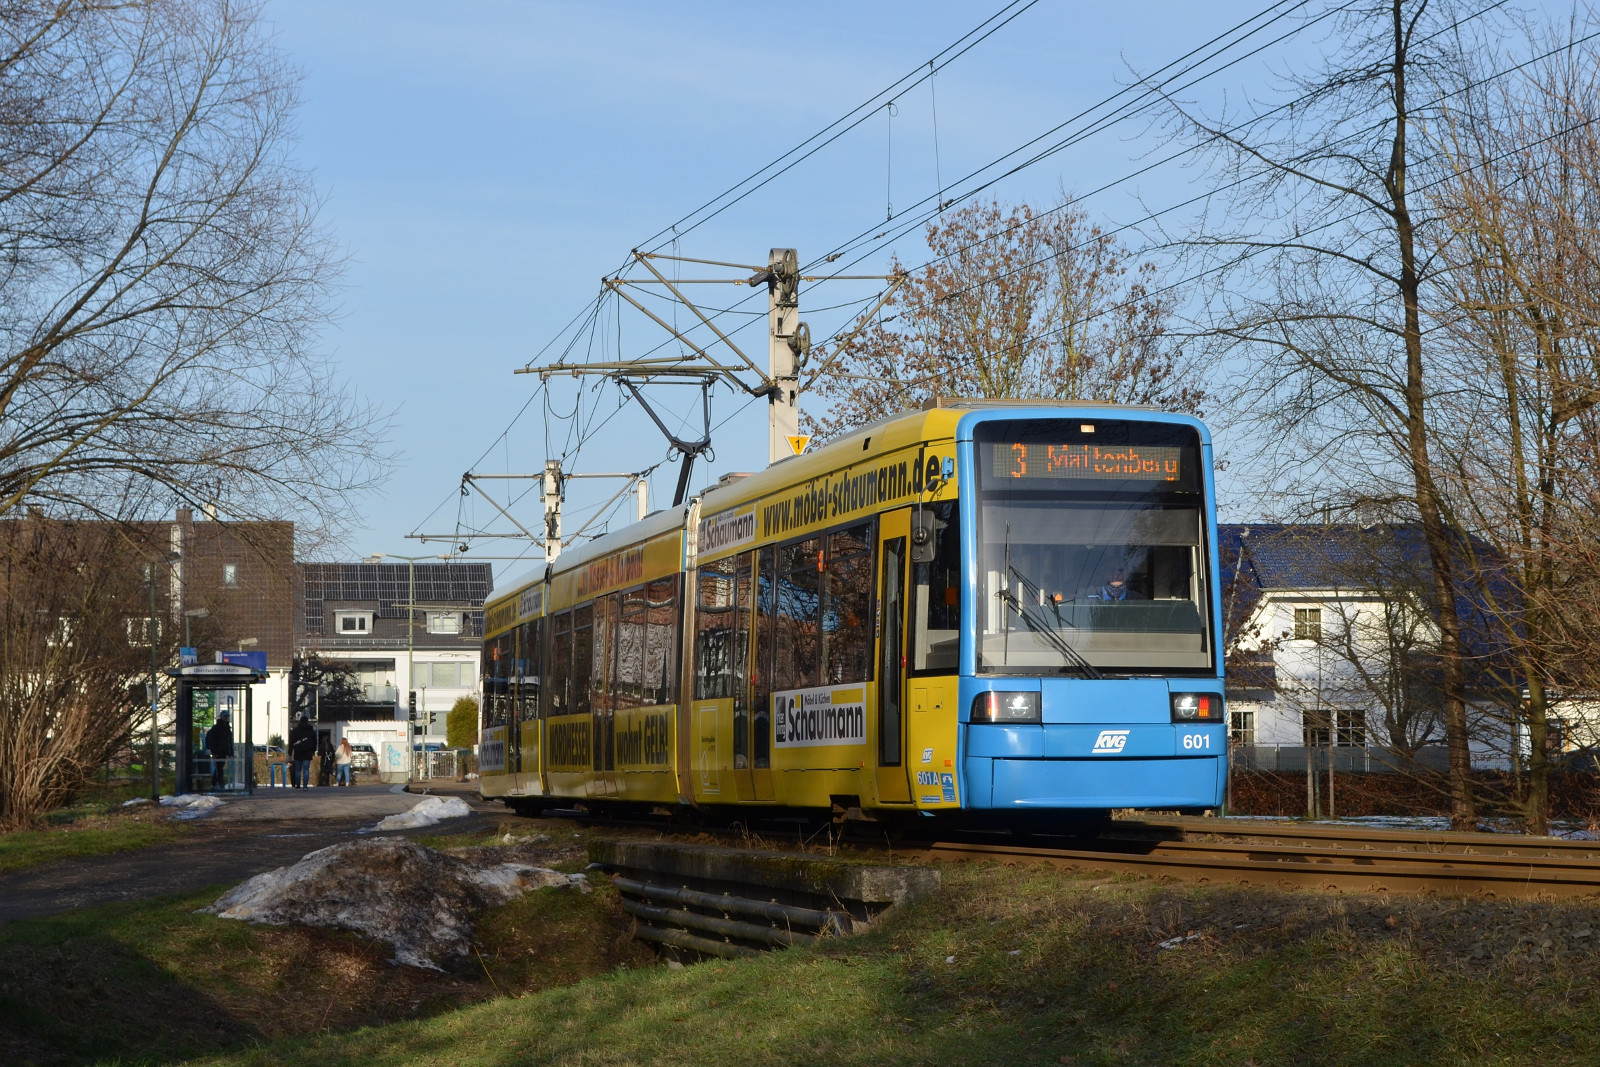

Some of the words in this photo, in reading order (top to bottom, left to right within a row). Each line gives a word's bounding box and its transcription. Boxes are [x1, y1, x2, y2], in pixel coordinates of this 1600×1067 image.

[795, 439, 800, 450] 1
[1011, 442, 1027, 478] 3
[763, 454, 940, 537] www.möbel-schaumann.de
[706, 513, 754, 550] Schaumann
[788, 694, 863, 742] Schaumann
[549, 722, 591, 766] NORDHESSEN
[616, 715, 642, 765] wohnt
[644, 712, 669, 765] GELB!
[1093, 733, 1129, 751] KVG
[1183, 734, 1210, 749] 601
